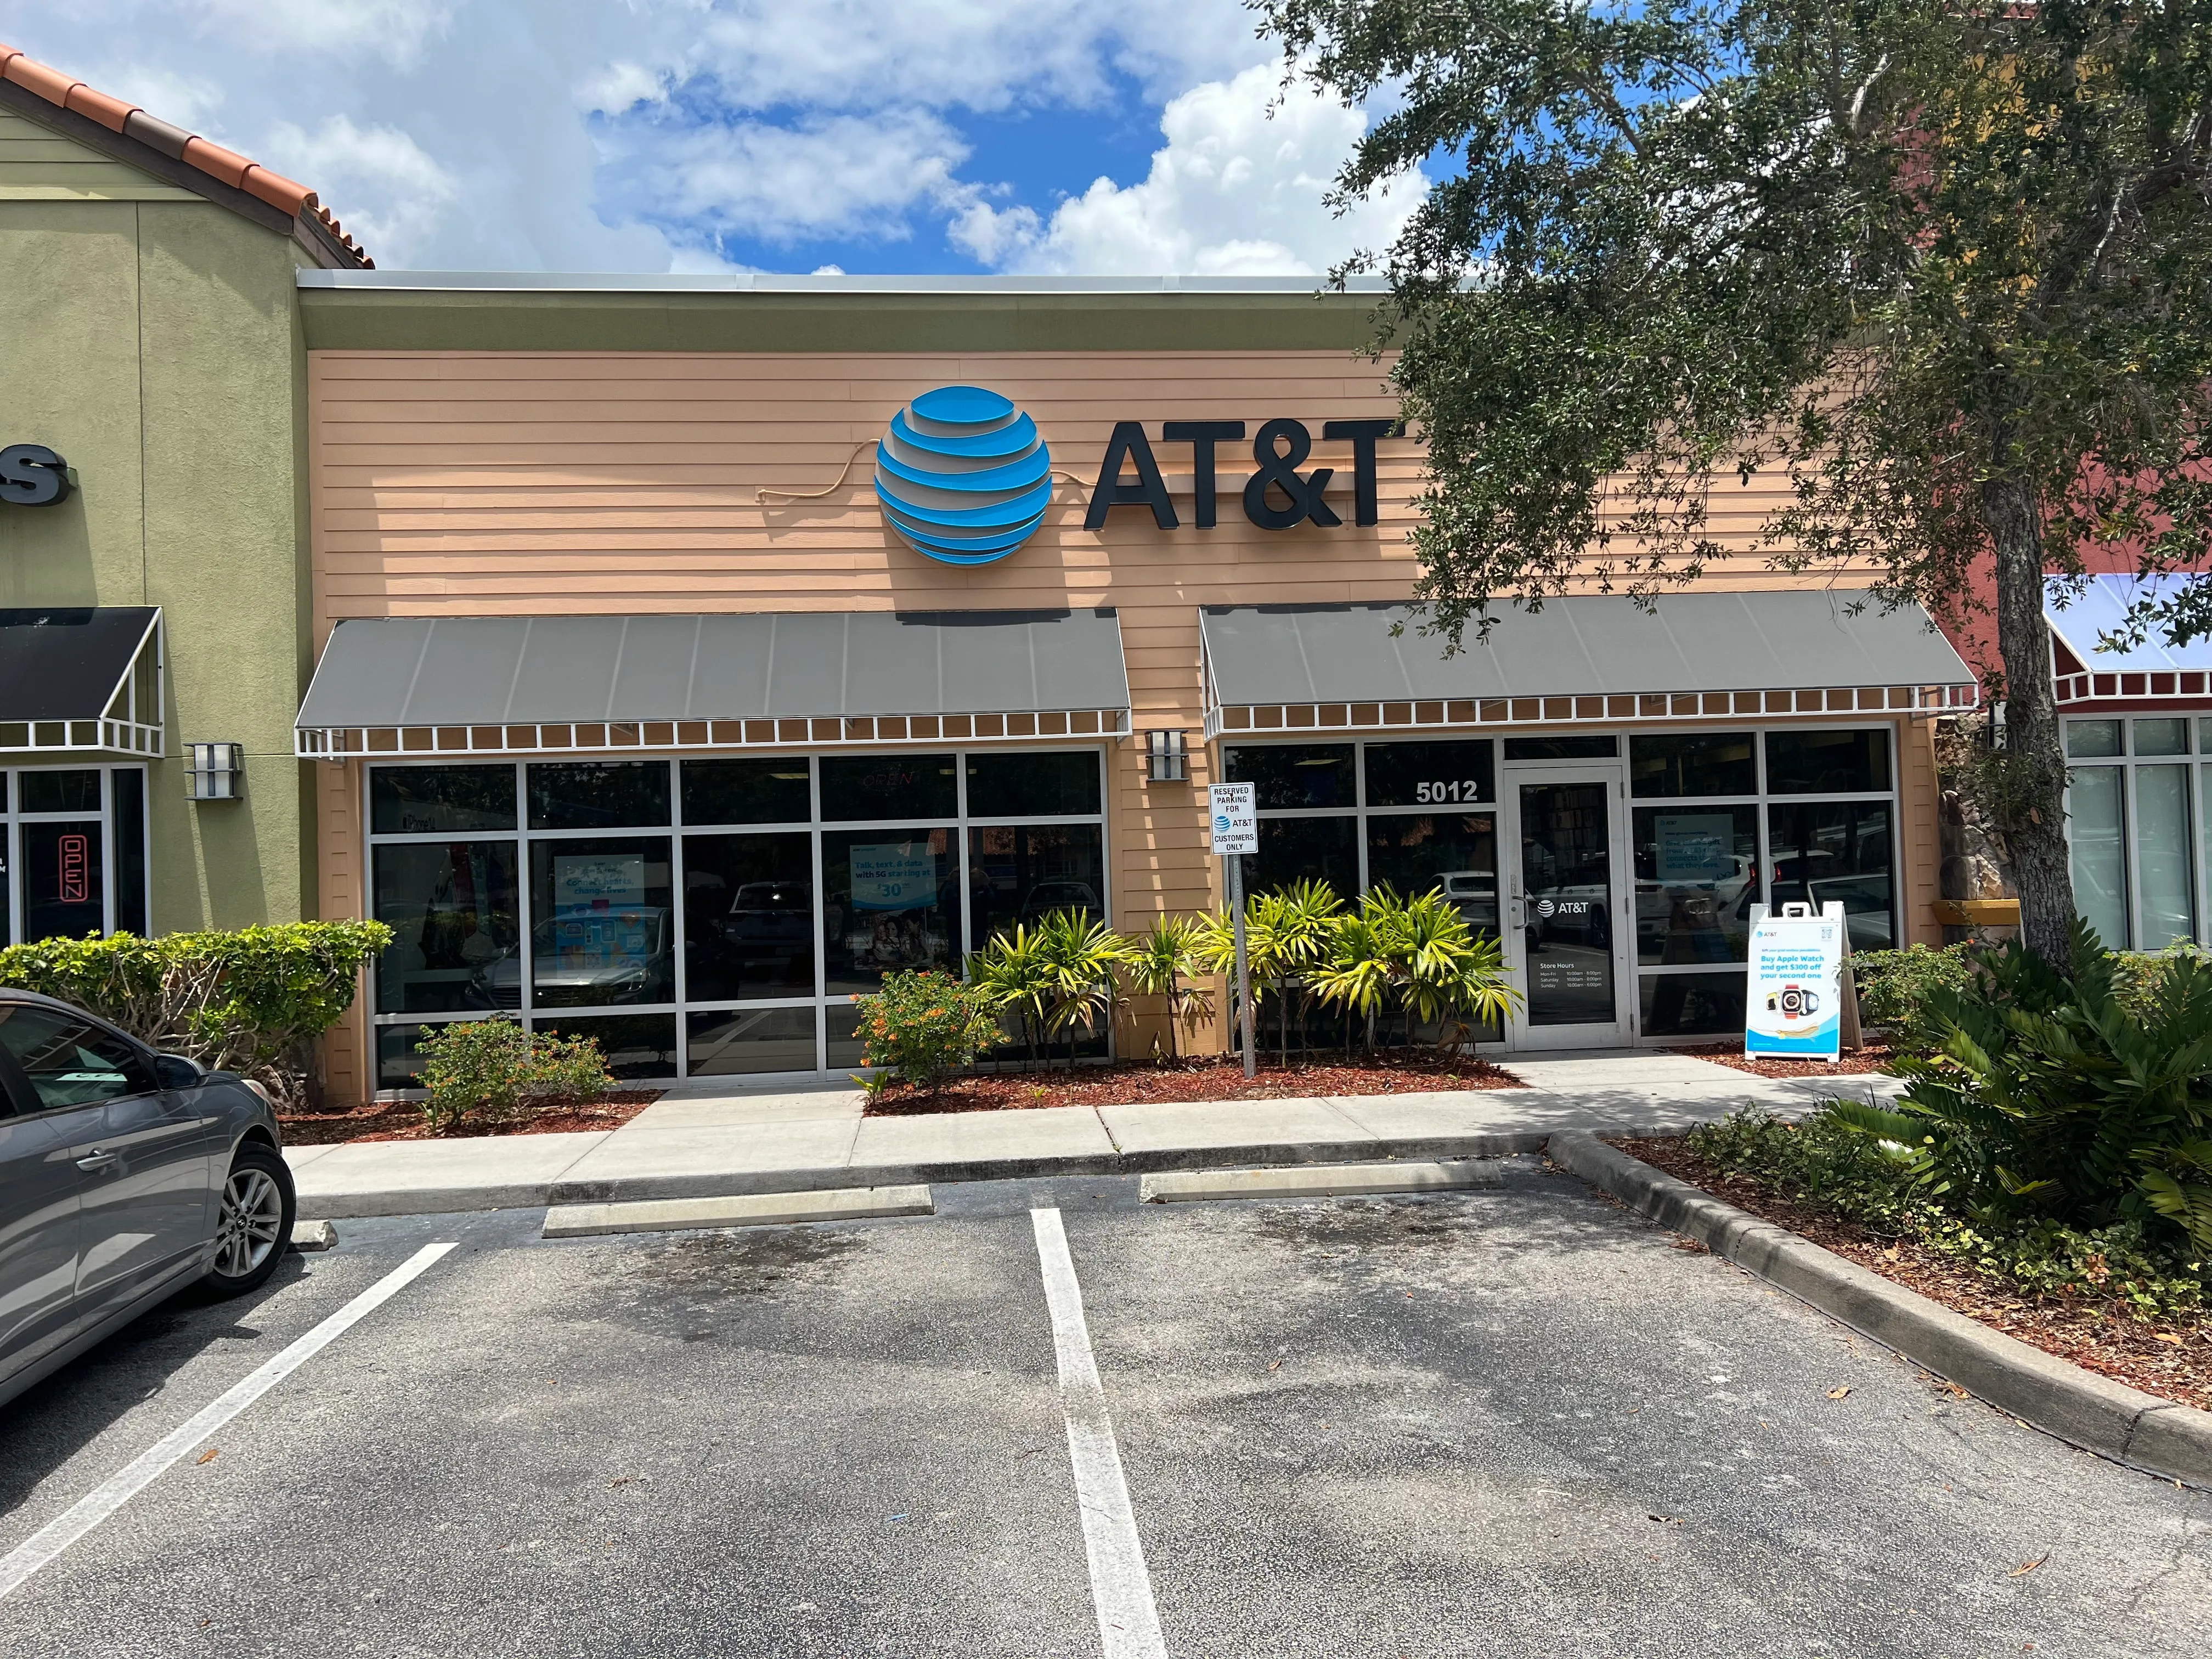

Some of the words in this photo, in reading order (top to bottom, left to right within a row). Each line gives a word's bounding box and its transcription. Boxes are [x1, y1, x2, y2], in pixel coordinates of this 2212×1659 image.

[1084, 418, 1406, 531] AT&T
[1417, 781, 1477, 802] 5012
[1215, 834, 1254, 842] CUSTOMERS
[65, 840, 82, 899] OPEN
[888, 869, 920, 877] starting
[574, 887, 606, 895] change
[1558, 902, 1589, 914] AT&T
